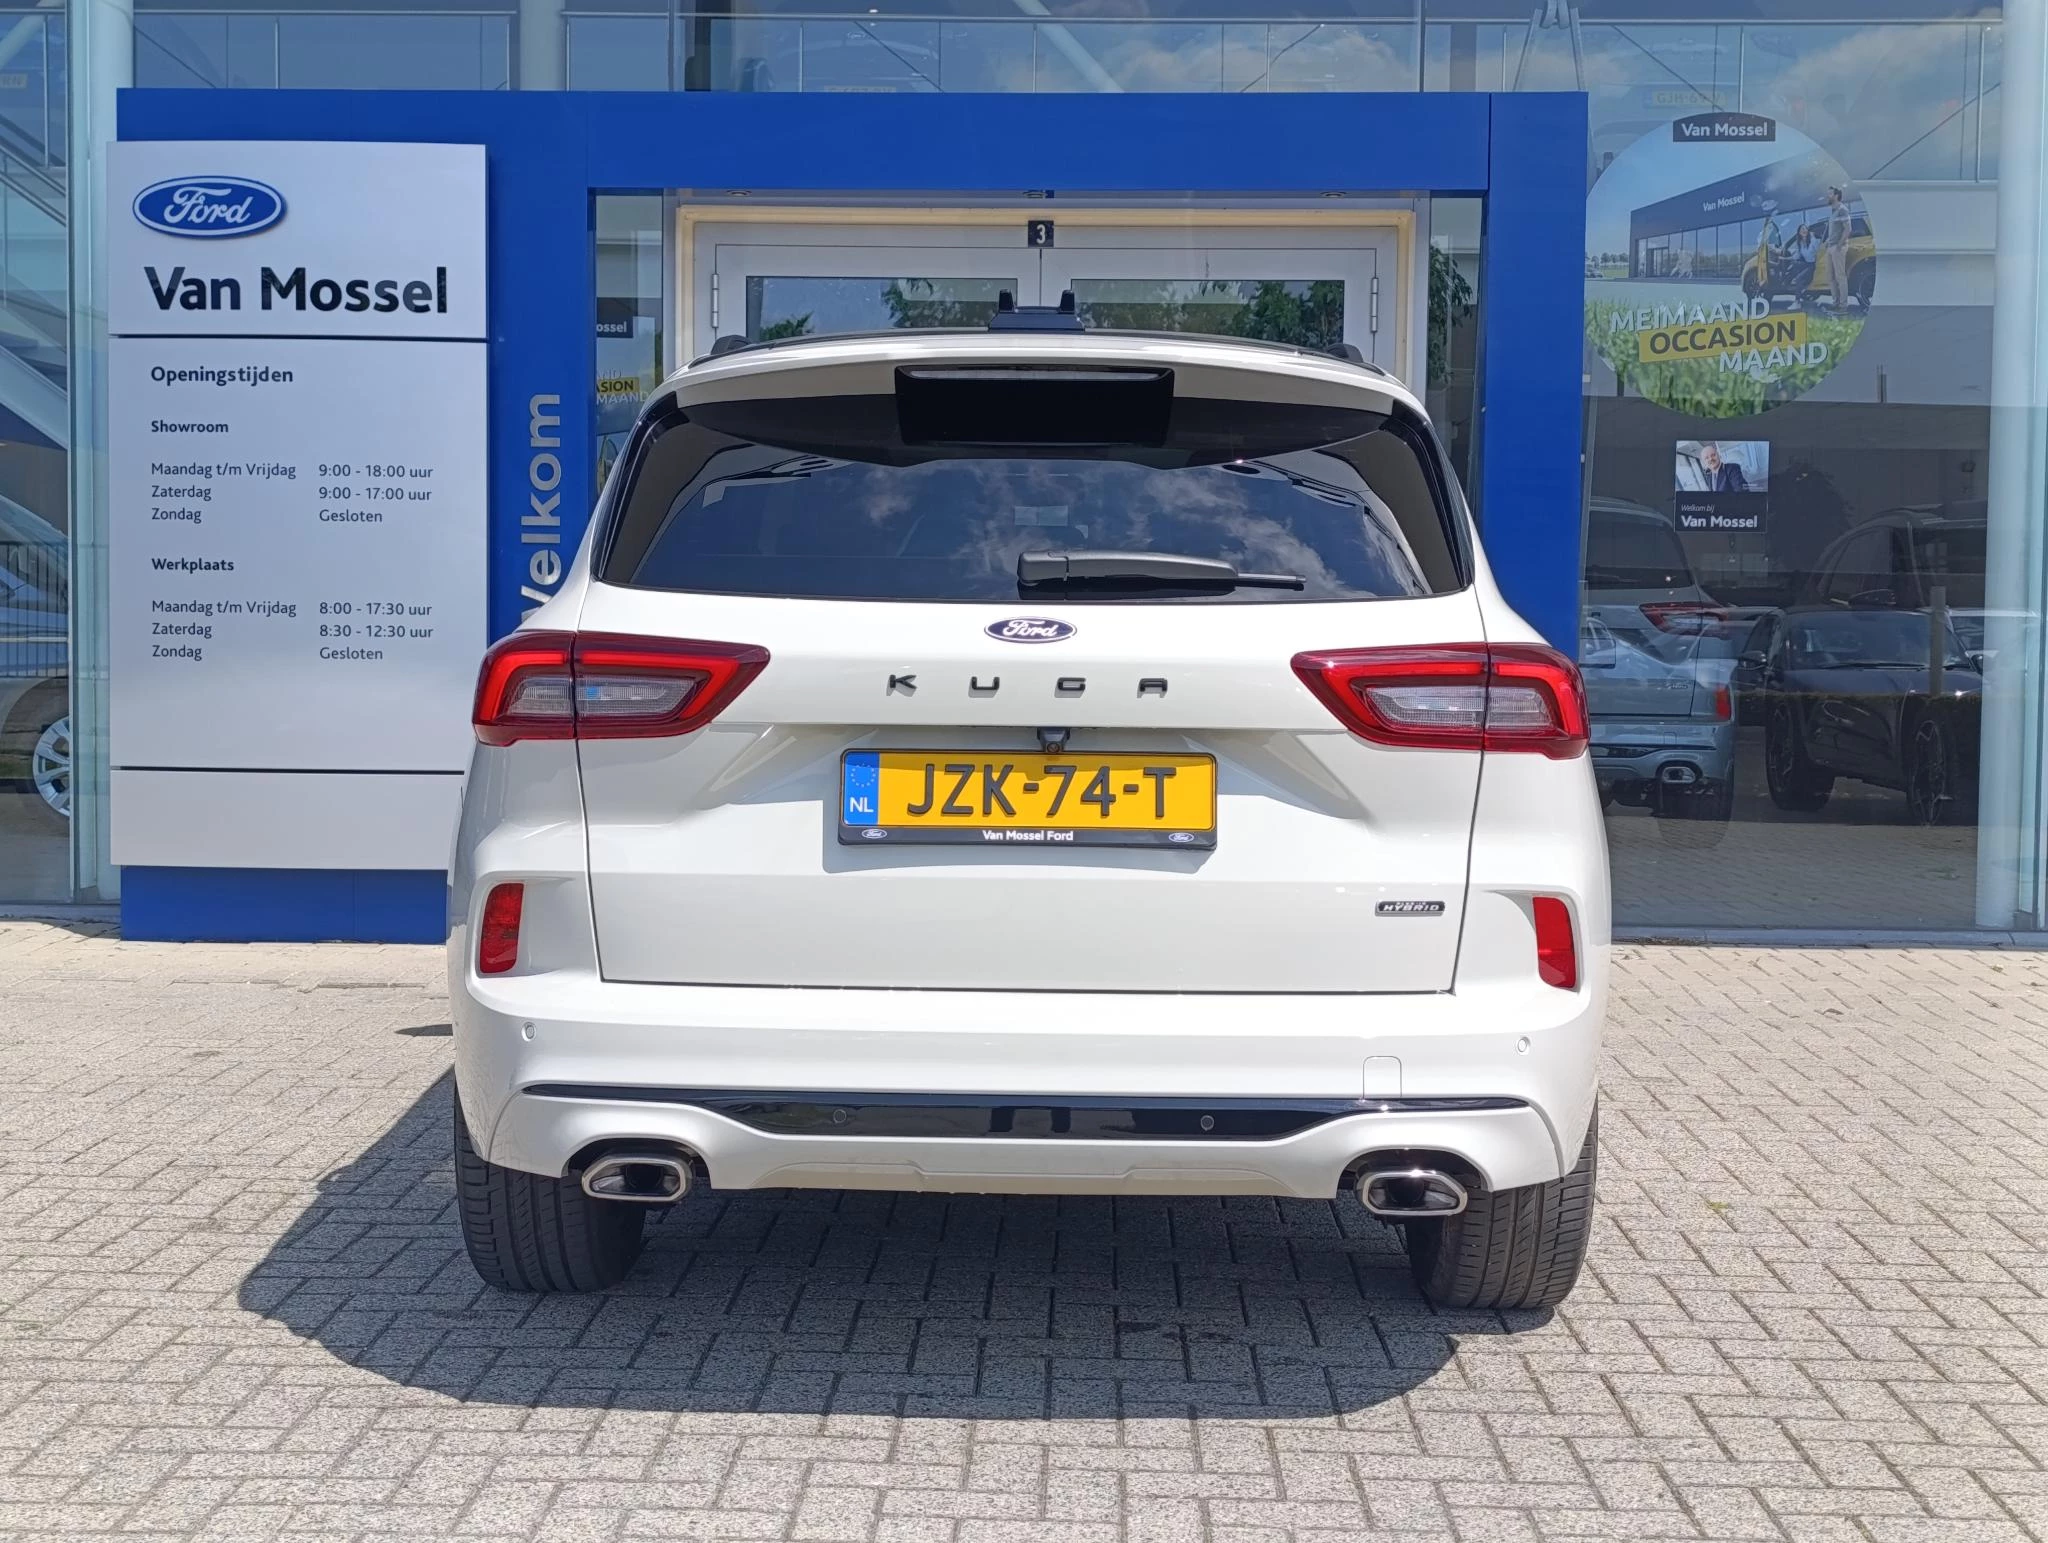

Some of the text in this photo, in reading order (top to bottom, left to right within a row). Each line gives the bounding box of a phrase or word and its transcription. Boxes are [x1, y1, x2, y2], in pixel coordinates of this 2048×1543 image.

[1681, 121, 1768, 136] Van Mossel
[164, 186, 253, 224] Ford
[1703, 191, 1745, 212] Van Mossel
[1036, 224, 1046, 244] 3
[144, 266, 447, 313] Van Mossel
[1650, 319, 1796, 354] OCCASION
[1719, 342, 1828, 373] MAAND
[151, 366, 293, 387] Openingstijden
[151, 420, 228, 432] Showroom
[152, 462, 212, 479] Maandag
[216, 462, 241, 476] t/m
[246, 463, 296, 479] Vrijdag
[319, 464, 351, 476] 9:00
[366, 465, 405, 477] 18:00
[410, 469, 433, 478] uur
[152, 484, 211, 501] Zaterdag
[319, 487, 351, 499] 9:00
[365, 488, 404, 500] 17:00
[409, 491, 432, 500] uur
[152, 507, 382, 524] Zondag Gesloten
[1681, 504, 1706, 512] Welkom
[1681, 515, 1758, 528] Van Mossel
[151, 557, 234, 574] Werkplaats
[152, 600, 213, 616] Maandag
[216, 600, 242, 613] t/m
[246, 601, 296, 617] Vrijdag
[320, 602, 352, 614] 8:00
[366, 603, 404, 615] 17:30
[409, 606, 432, 616] uur
[152, 622, 212, 639] Zaterdag
[320, 624, 351, 637] 8:30
[366, 625, 405, 637] 12:30
[410, 629, 433, 638] uur
[1002, 618, 1059, 637] Ford
[152, 644, 383, 661] Zondag Gesloten
[889, 674, 1168, 693] KUGA
[907, 763, 1178, 818] JZK-74-T
[850, 798, 874, 813] NL
[982, 829, 1074, 840] Van Mossel Ford
